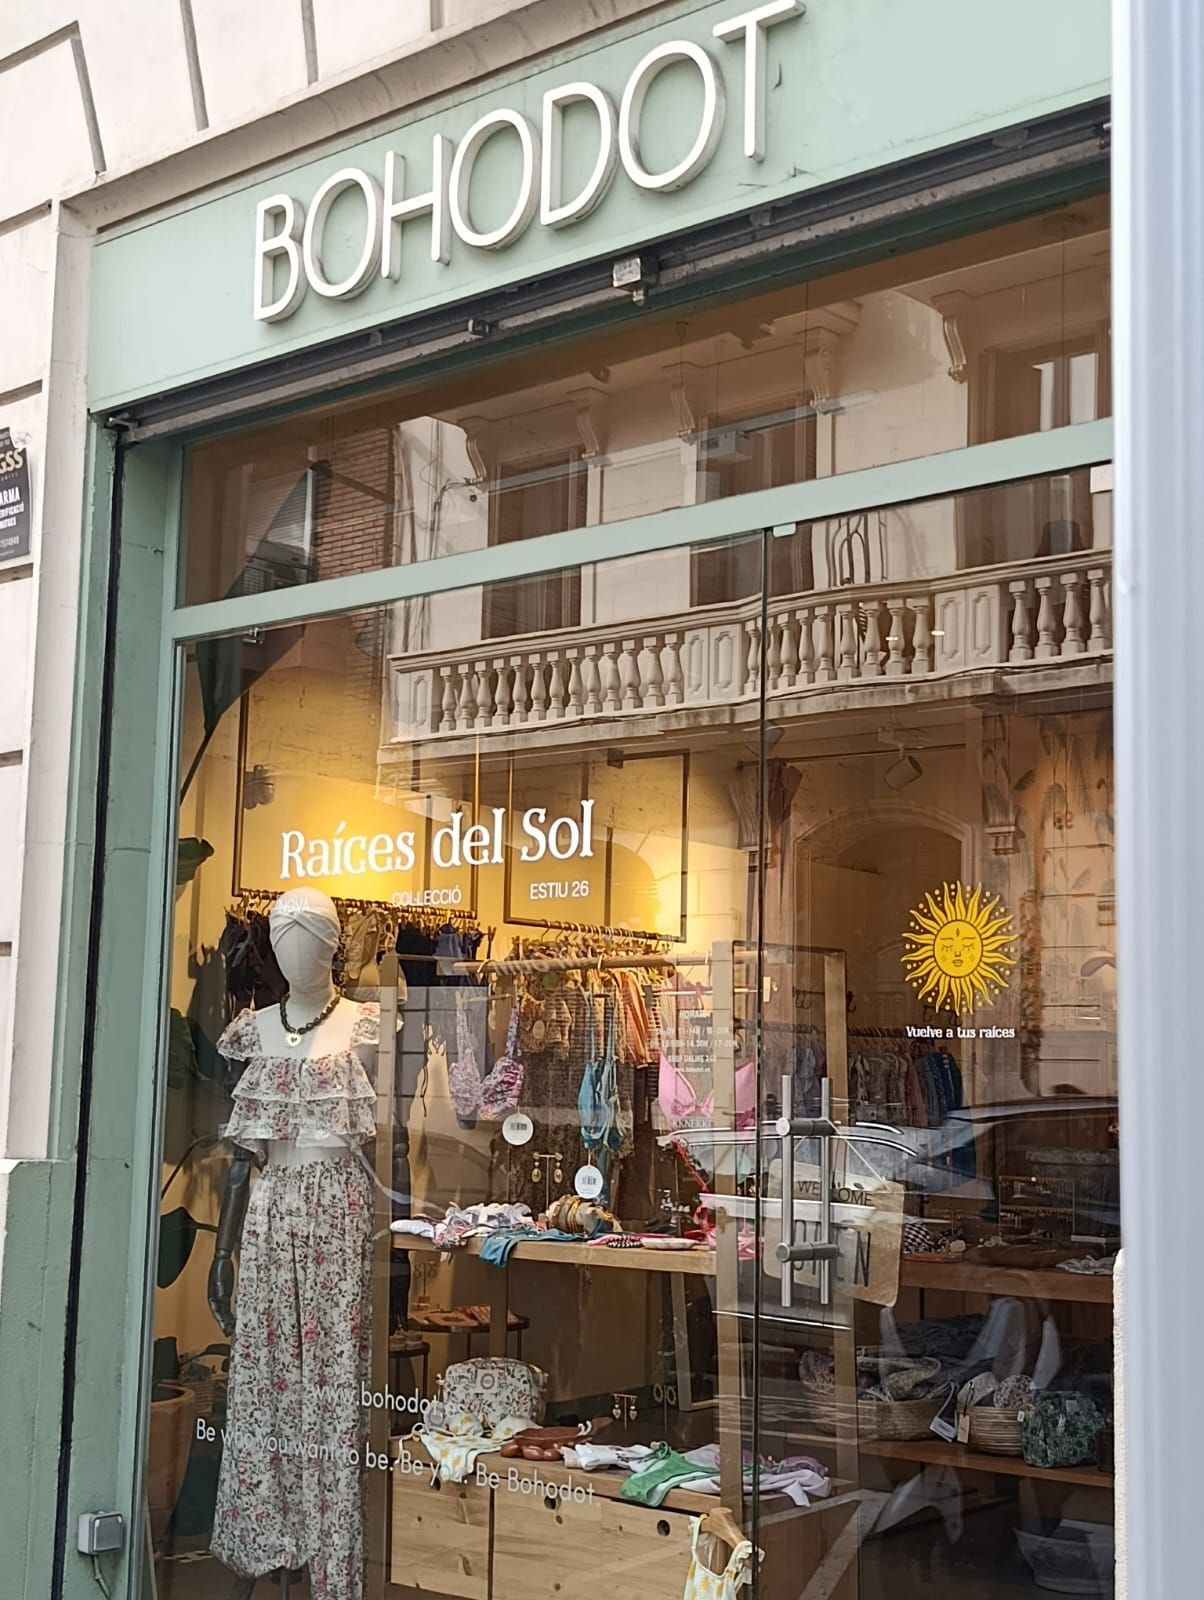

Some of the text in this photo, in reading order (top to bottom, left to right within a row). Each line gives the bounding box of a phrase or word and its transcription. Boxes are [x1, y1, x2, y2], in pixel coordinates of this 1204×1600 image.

[253, 0, 803, 323] BOHODOT
[280, 799, 595, 879] Raíces del Sol
[530, 881, 568, 900] ESTIU
[572, 880, 589, 897] 26
[905, 1025, 1016, 1039] Vuelve a tus raíces
[795, 1181, 873, 1206] WEOME
[196, 1418, 216, 1442] Be
[260, 1436, 287, 1455] you
[365, 1442, 394, 1472] be.
[400, 1449, 424, 1476] Be
[476, 1462, 500, 1489] Be
